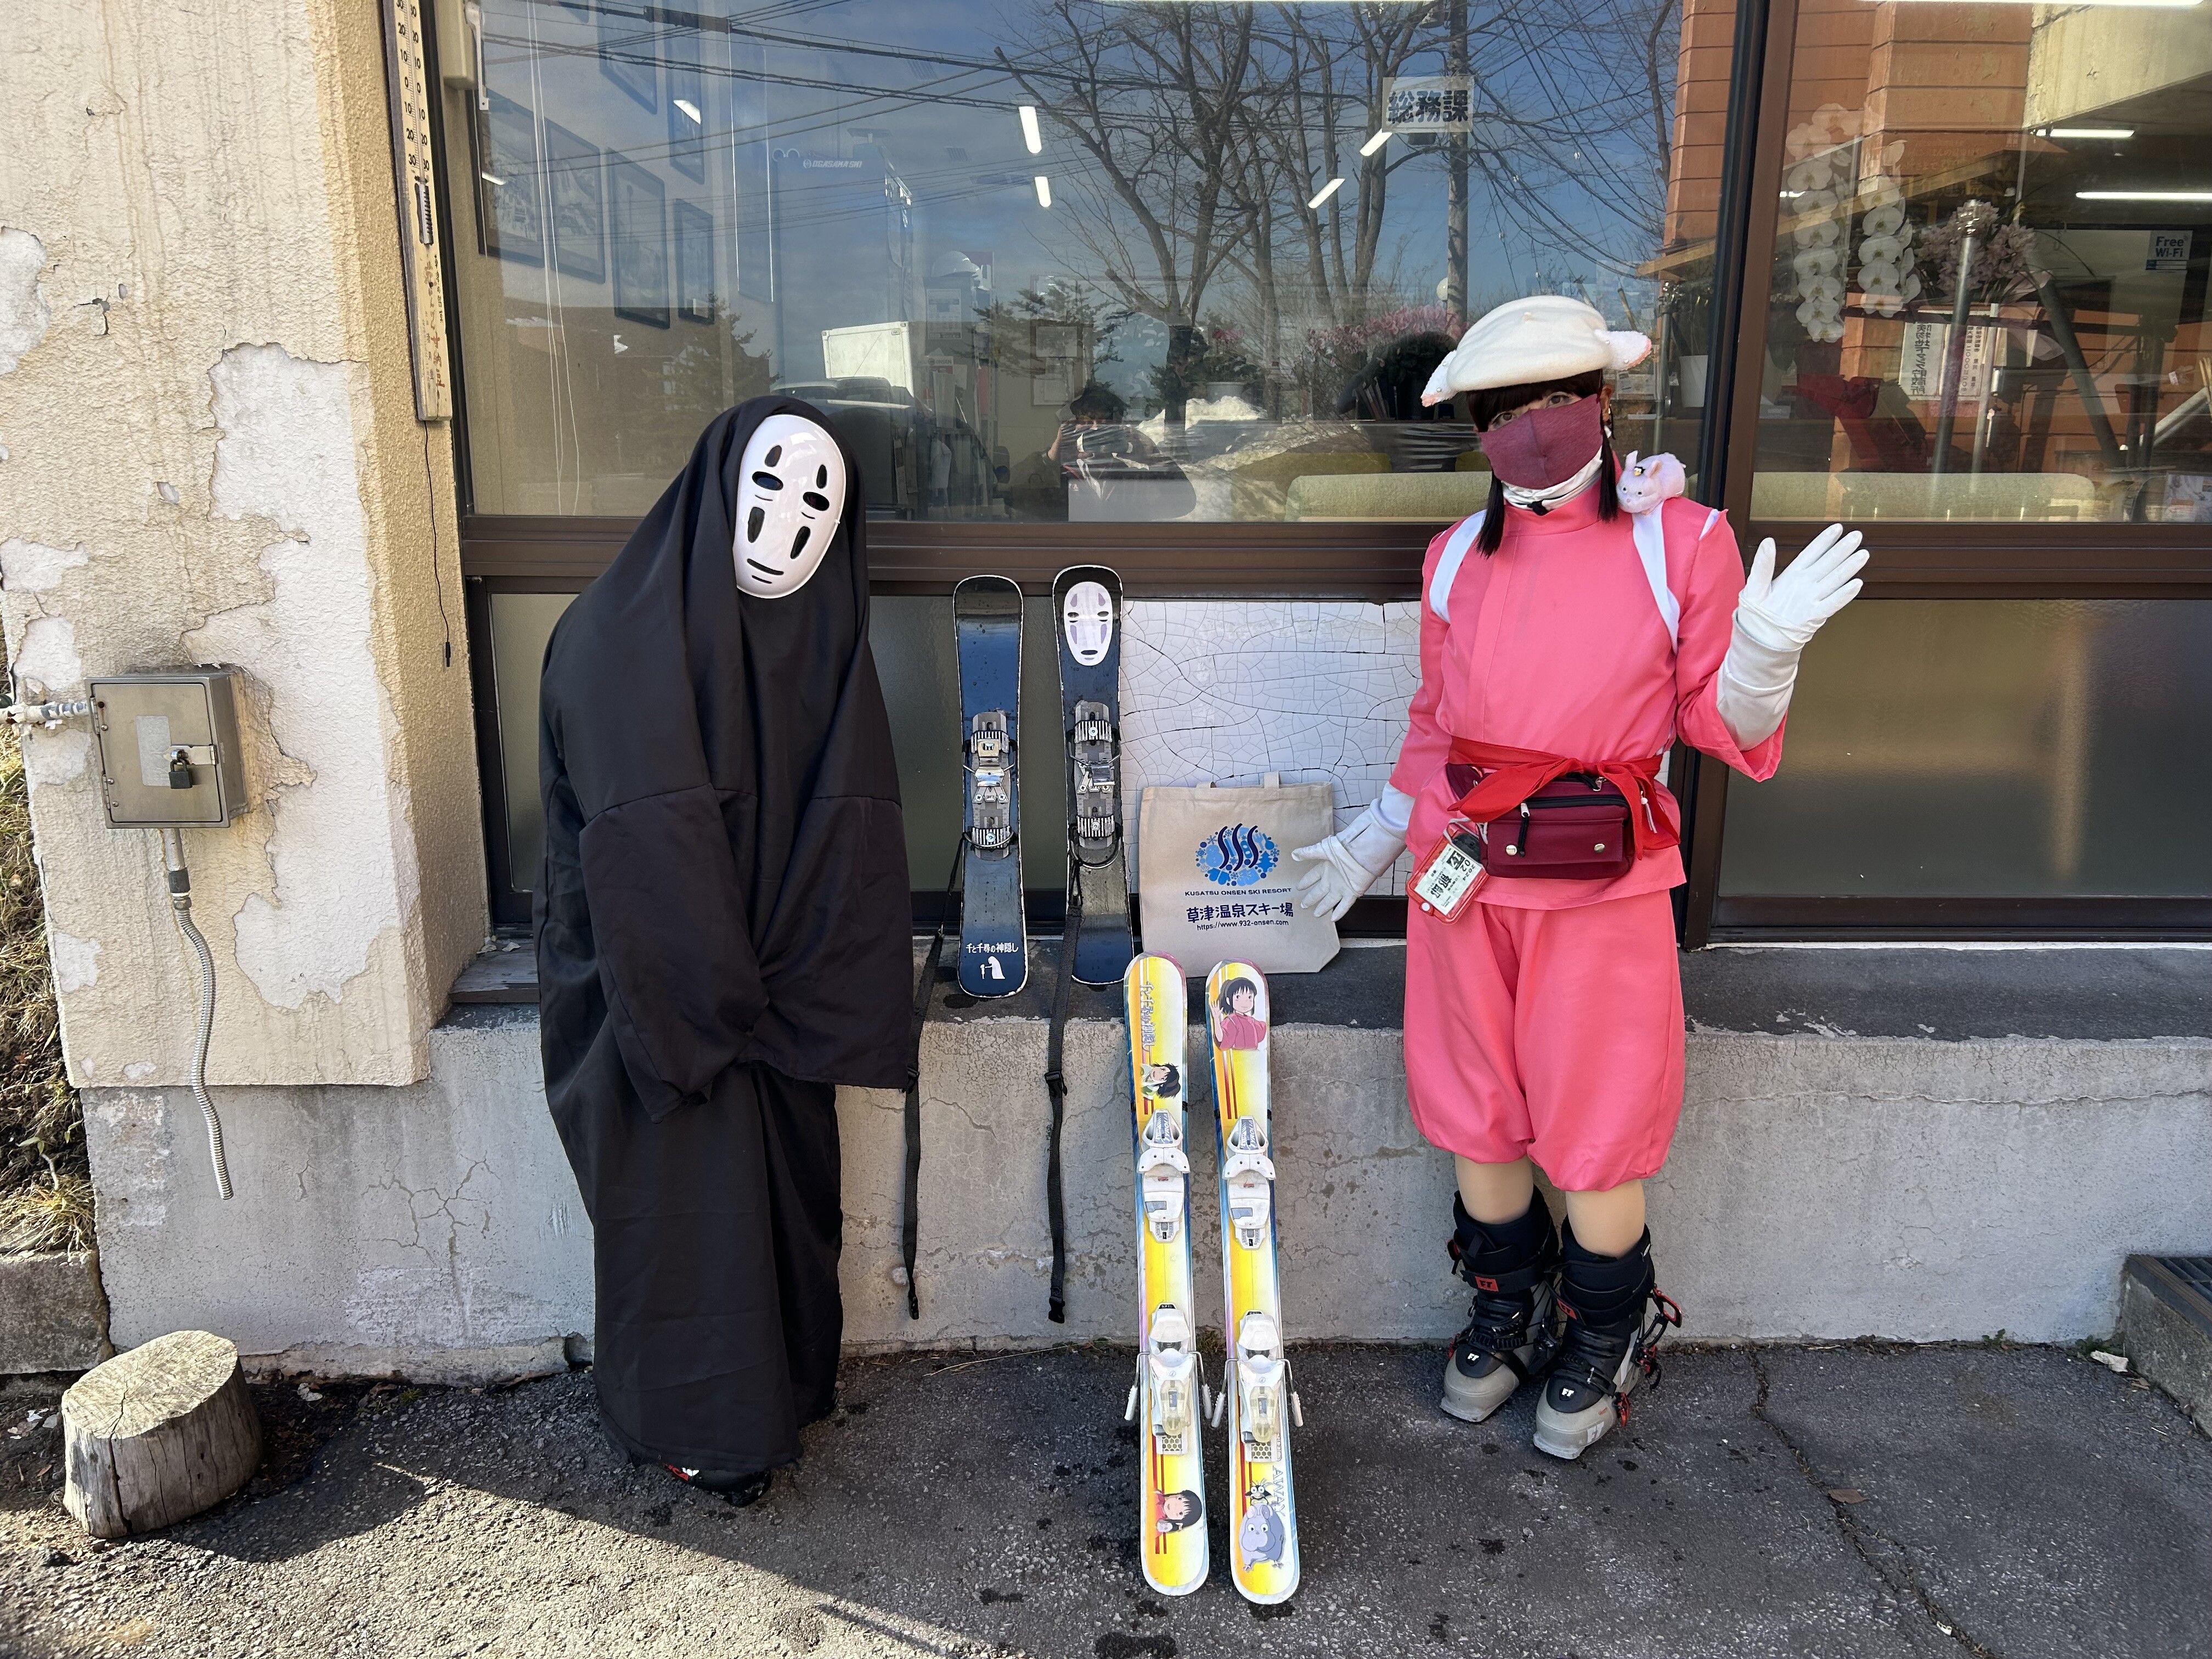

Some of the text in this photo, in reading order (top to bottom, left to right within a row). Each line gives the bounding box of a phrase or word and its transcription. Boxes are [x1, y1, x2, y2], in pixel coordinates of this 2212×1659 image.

[398, 22, 405, 36] 20
[400, 49, 407, 62] 10
[415, 57, 421, 69] 10
[404, 76, 409, 88] 0
[417, 82, 421, 93] 0
[404, 101, 412, 114] 10
[1388, 89, 1469, 124] 総務課
[419, 108, 425, 120] 10
[406, 128, 414, 141] 20
[421, 133, 427, 145] 20
[408, 153, 416, 166] 30
[423, 158, 430, 171] 30
[2155, 236, 2184, 247] Free
[2155, 247, 2183, 257] Wi-Fi
[1460, 859, 1471, 872] 02
[1463, 864, 1476, 881] 2024
[1186, 902, 1294, 923] 草津温泉スキー場
[1197, 919, 1289, 931] https://www.932-onsen.com
[966, 942, 1019, 953] 千と千尋の神隠し
[1140, 981, 1156, 1052] 千と千尋の神隠し
[1479, 1280, 1493, 1288] FT
[1560, 1302, 1571, 1314] FT
[1467, 1353, 1480, 1361] FT
[1561, 1387, 1575, 1397] FT
